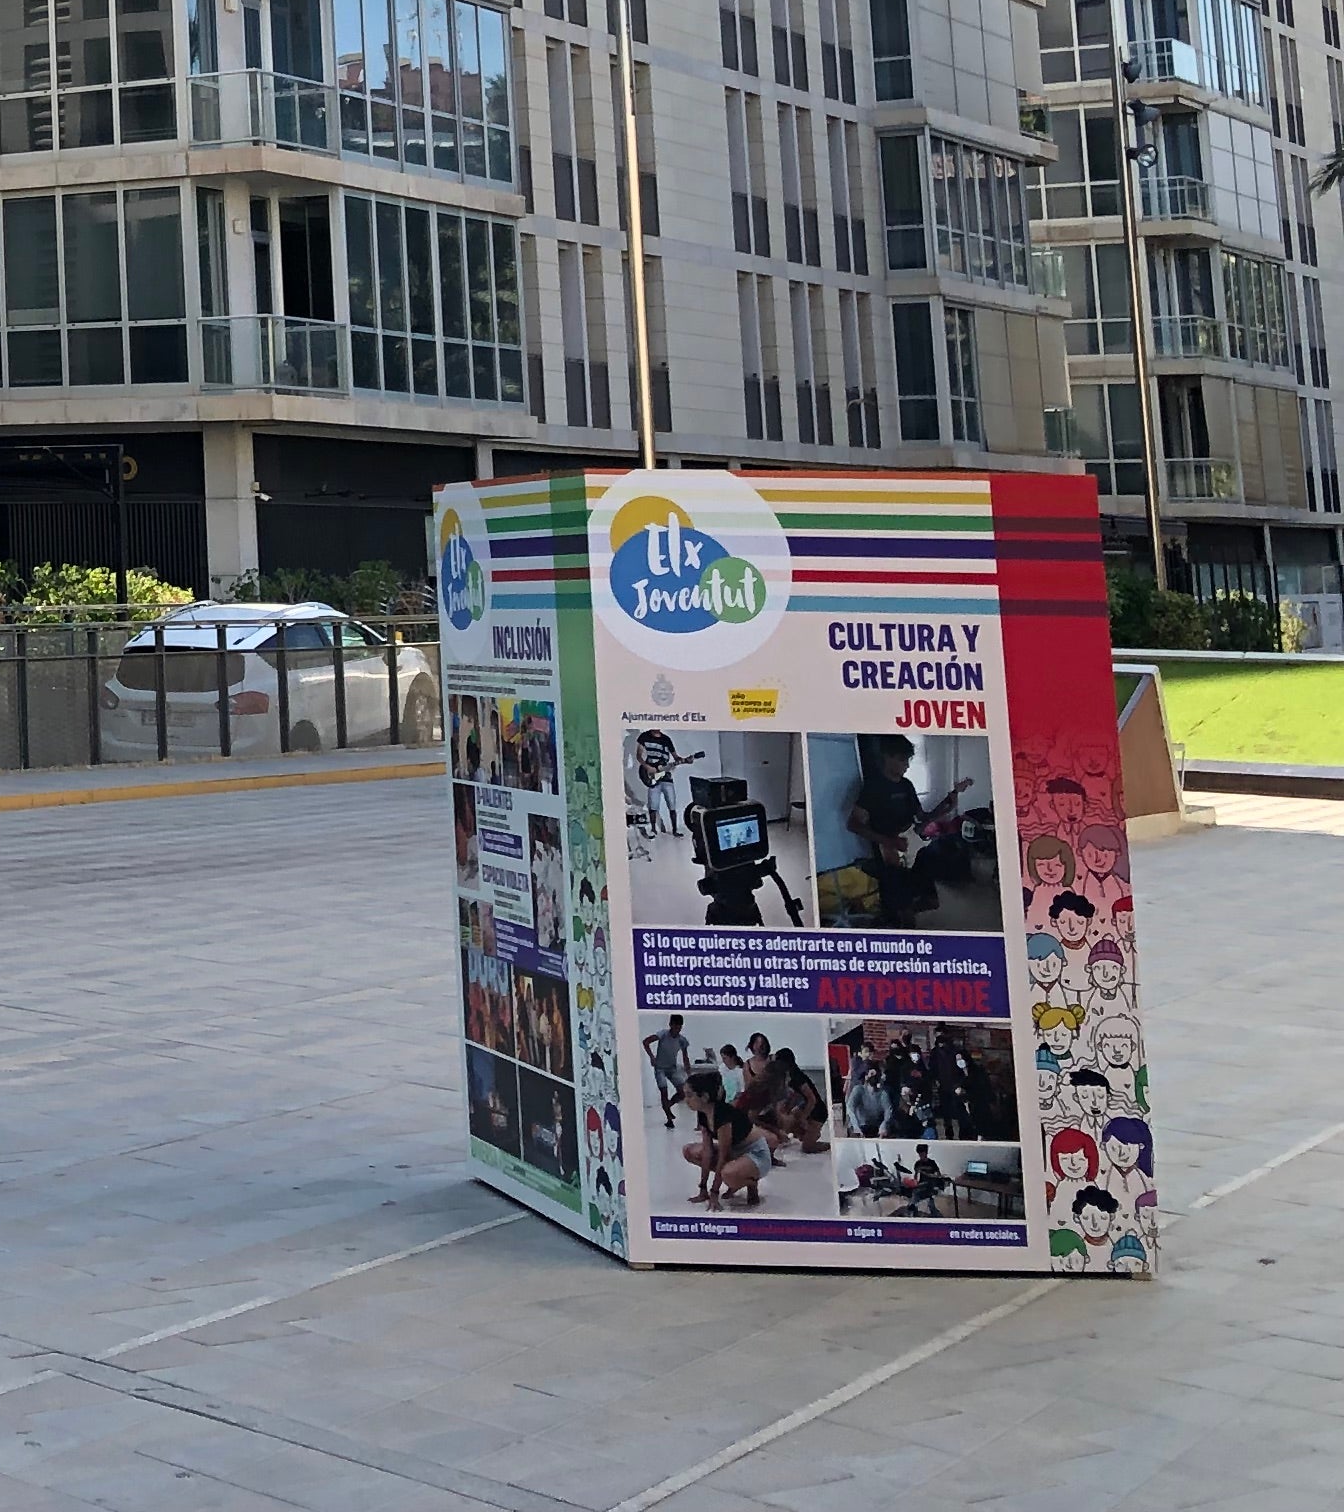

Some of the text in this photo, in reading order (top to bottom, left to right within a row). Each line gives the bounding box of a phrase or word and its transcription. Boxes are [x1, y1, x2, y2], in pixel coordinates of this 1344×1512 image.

[644, 510, 704, 578] Elx
[632, 566, 759, 622] Joventut
[493, 618, 552, 661] INCLUSIÓN
[828, 621, 981, 653] CULTURA Y
[842, 654, 984, 691] CREACIÓN
[622, 712, 706, 723] Ajuntament d'Elx
[895, 699, 987, 729] JOVEN
[642, 933, 932, 954] Si lo que quieres es adentrarte en el mundo de
[644, 952, 656, 967] la
[658, 952, 751, 971] interpretación
[764, 956, 798, 971] otras
[801, 955, 846, 971] formas
[849, 957, 865, 972] de
[867, 956, 929, 976] expresión
[932, 958, 992, 977] artística,
[645, 973, 809, 990] nuestros cursos y talleres
[816, 976, 991, 1012] ARTPRENDE
[646, 991, 792, 1009] están pensados para ti.
